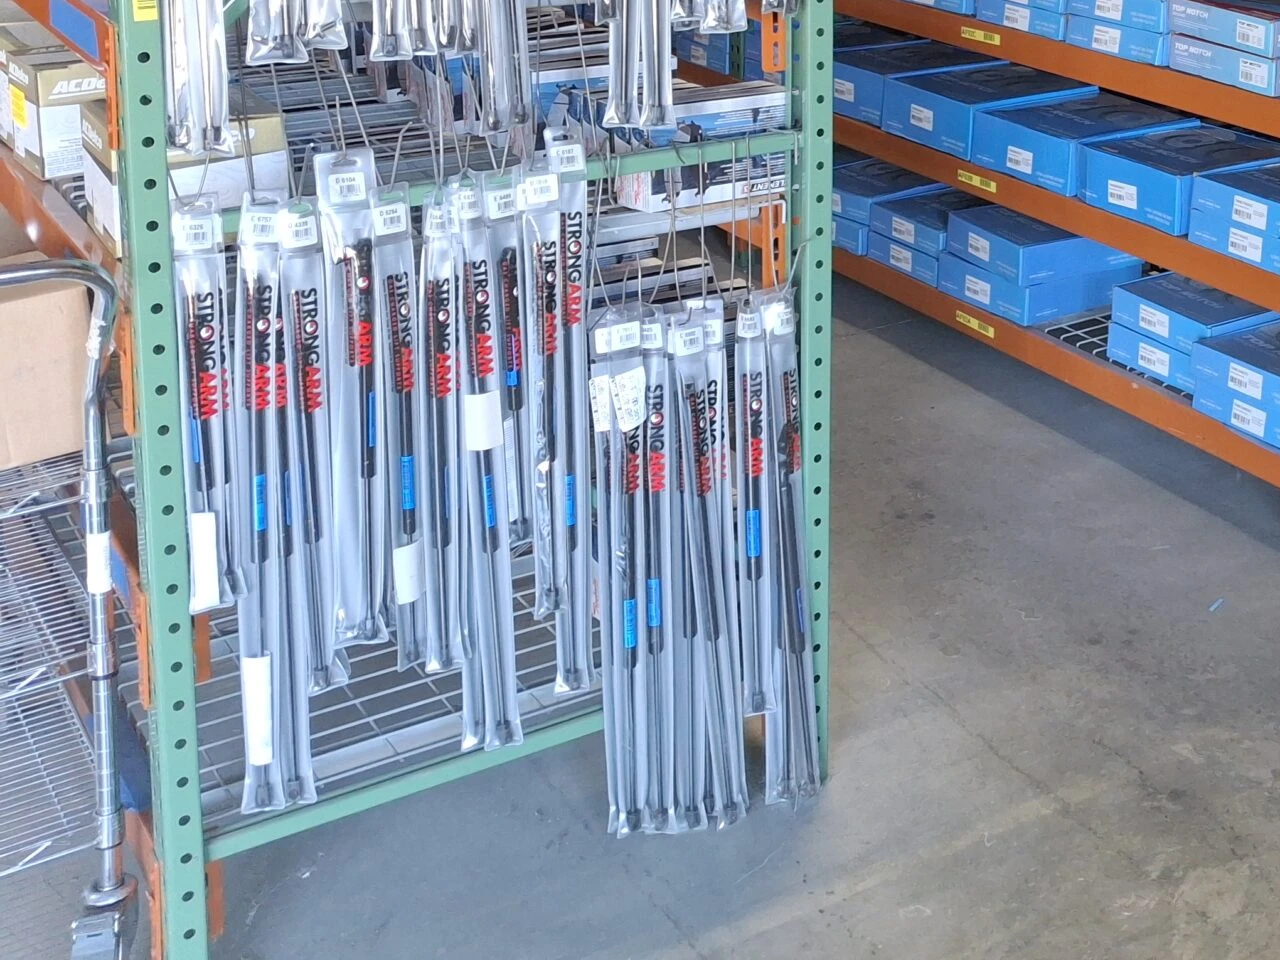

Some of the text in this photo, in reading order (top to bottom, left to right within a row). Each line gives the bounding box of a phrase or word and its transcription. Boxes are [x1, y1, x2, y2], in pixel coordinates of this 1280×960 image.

[1172, 3, 1209, 20] TOP NOTCH
[1175, 42, 1212, 57] TOP NOTCH
[50, 77, 107, 94] ACDe
[472, 259, 494, 378] STRONGARM
[567, 210, 582, 327] STRONGARM
[198, 291, 218, 420] STRONGARM
[255, 285, 272, 412] STRONGARM
[301, 288, 323, 413] STRONGARM
[394, 271, 415, 392] STRONGARM
[436, 277, 452, 400] STRONGARM
[650, 383, 666, 494] STRONGARM
[749, 371, 764, 478] STRONGARM
